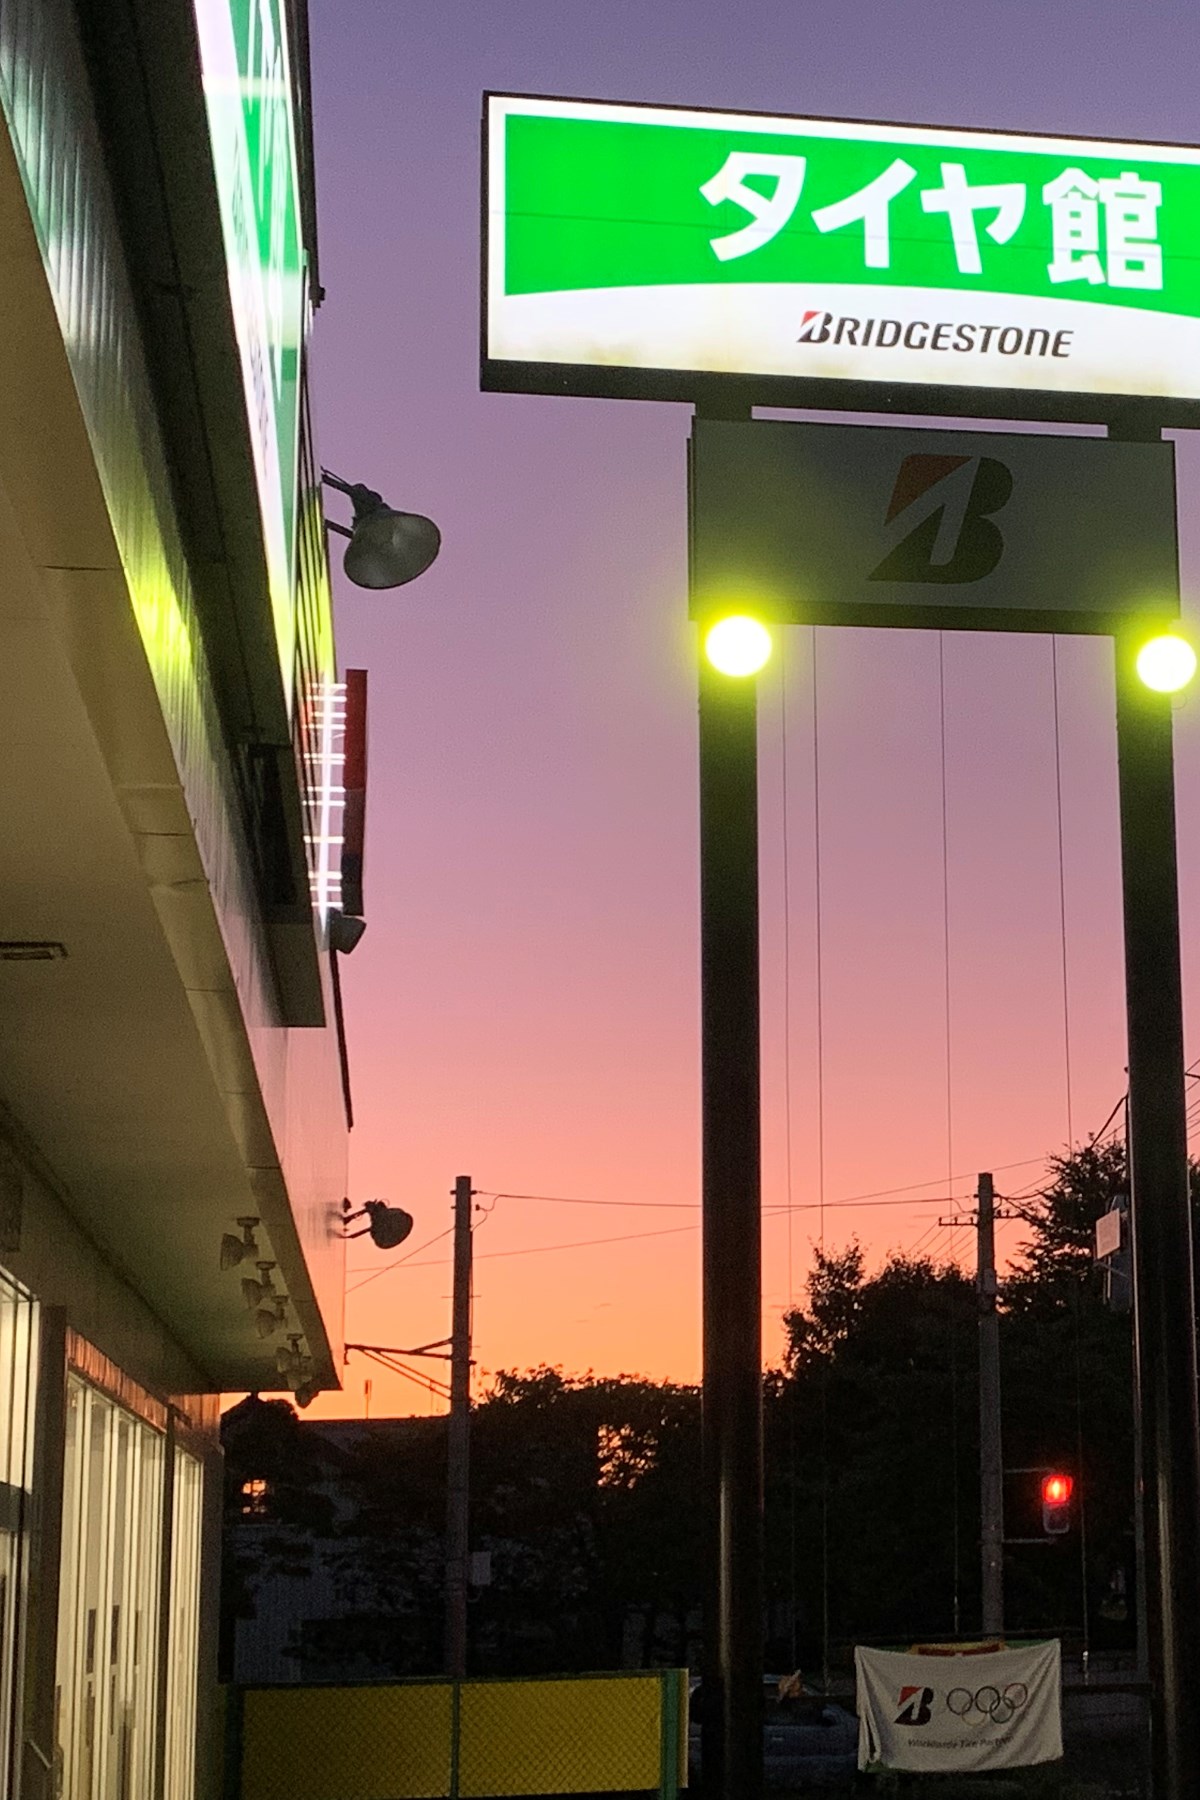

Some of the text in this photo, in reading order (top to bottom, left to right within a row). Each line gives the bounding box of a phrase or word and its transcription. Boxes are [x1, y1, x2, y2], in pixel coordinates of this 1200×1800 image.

[699, 151, 1163, 290] タイヤ館
[797, 310, 1074, 358] BRIDGESTONE
